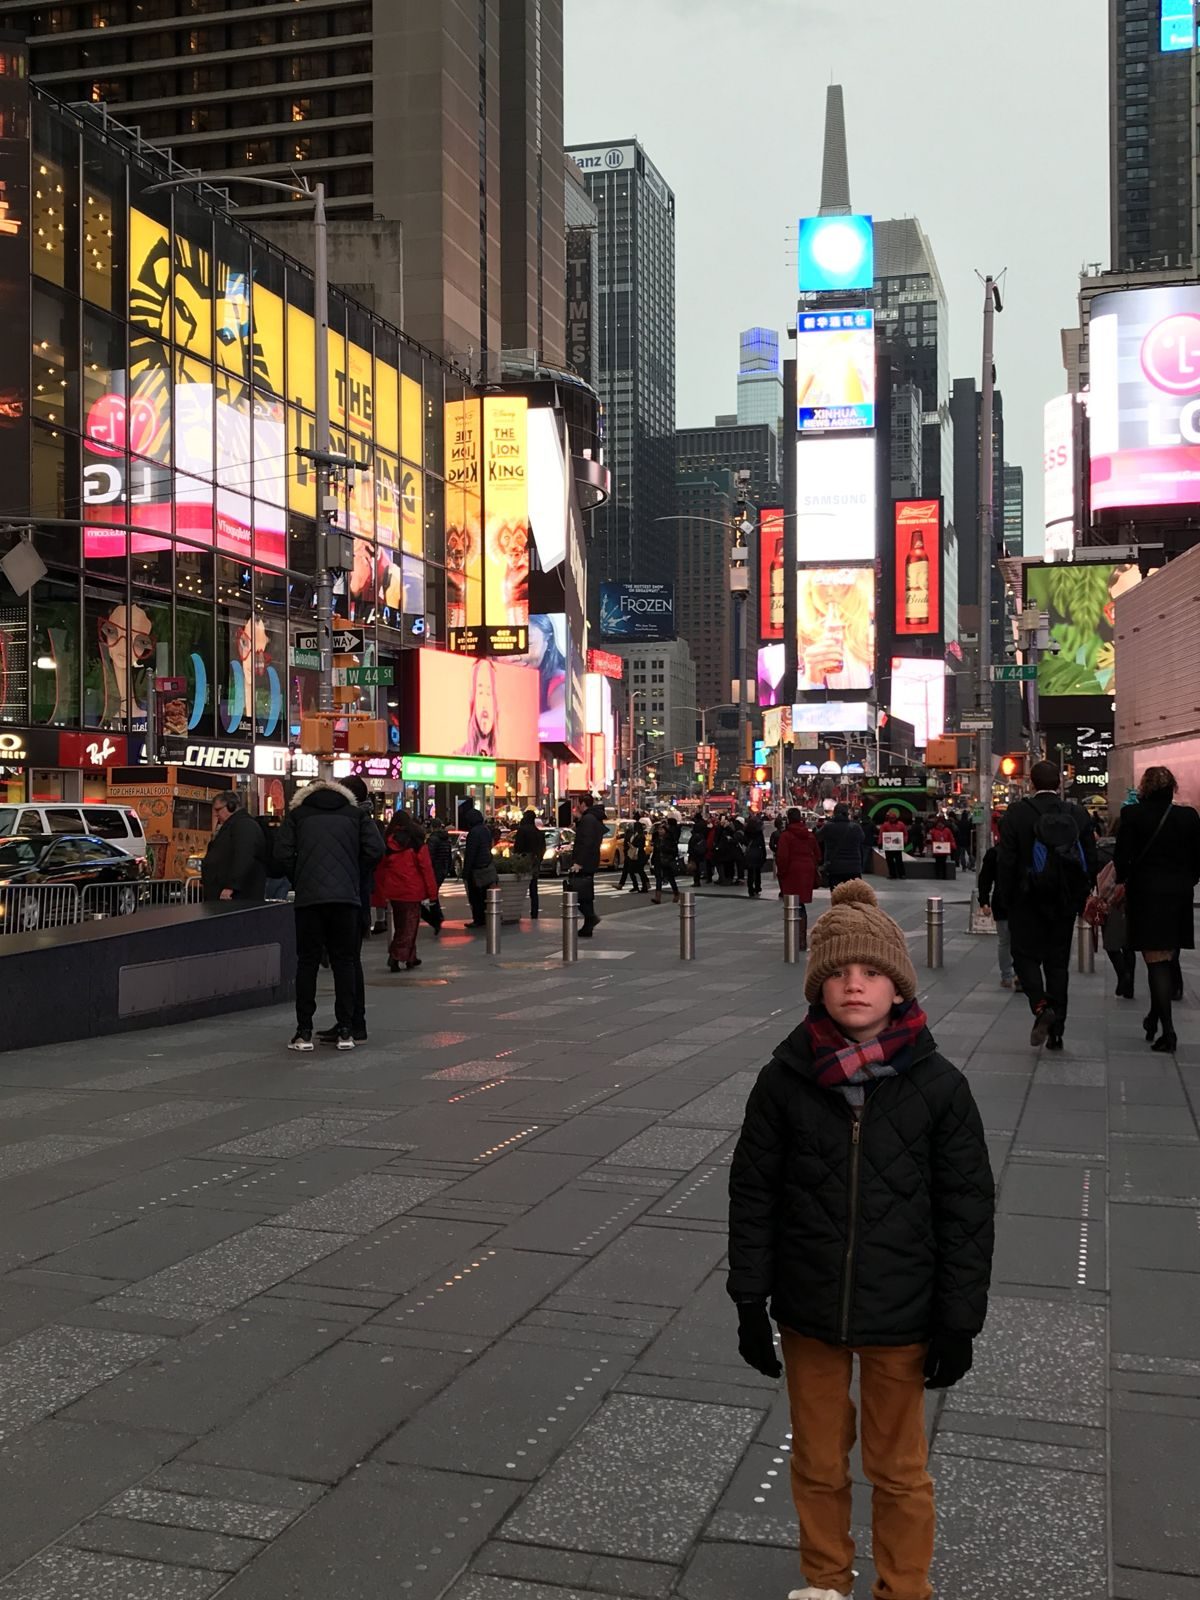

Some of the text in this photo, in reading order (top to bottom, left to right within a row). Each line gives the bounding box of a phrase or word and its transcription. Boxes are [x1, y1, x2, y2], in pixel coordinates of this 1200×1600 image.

[572, 155, 602, 168] anz
[568, 258, 588, 364] TIMES
[335, 368, 372, 421] THE
[493, 427, 516, 438] THE
[490, 440, 519, 459] LION
[488, 460, 524, 481] KING
[804, 494, 868, 506] SAMSUNG
[620, 595, 672, 615] FROZEN
[305, 636, 353, 648] ON WAY
[348, 669, 392, 684] W 44 St
[995, 667, 1004, 679] W
[1008, 667, 1023, 679] 44
[878, 777, 902, 787] NYC
[110, 787, 170, 796] TOP CHEF HALAL FOOD
